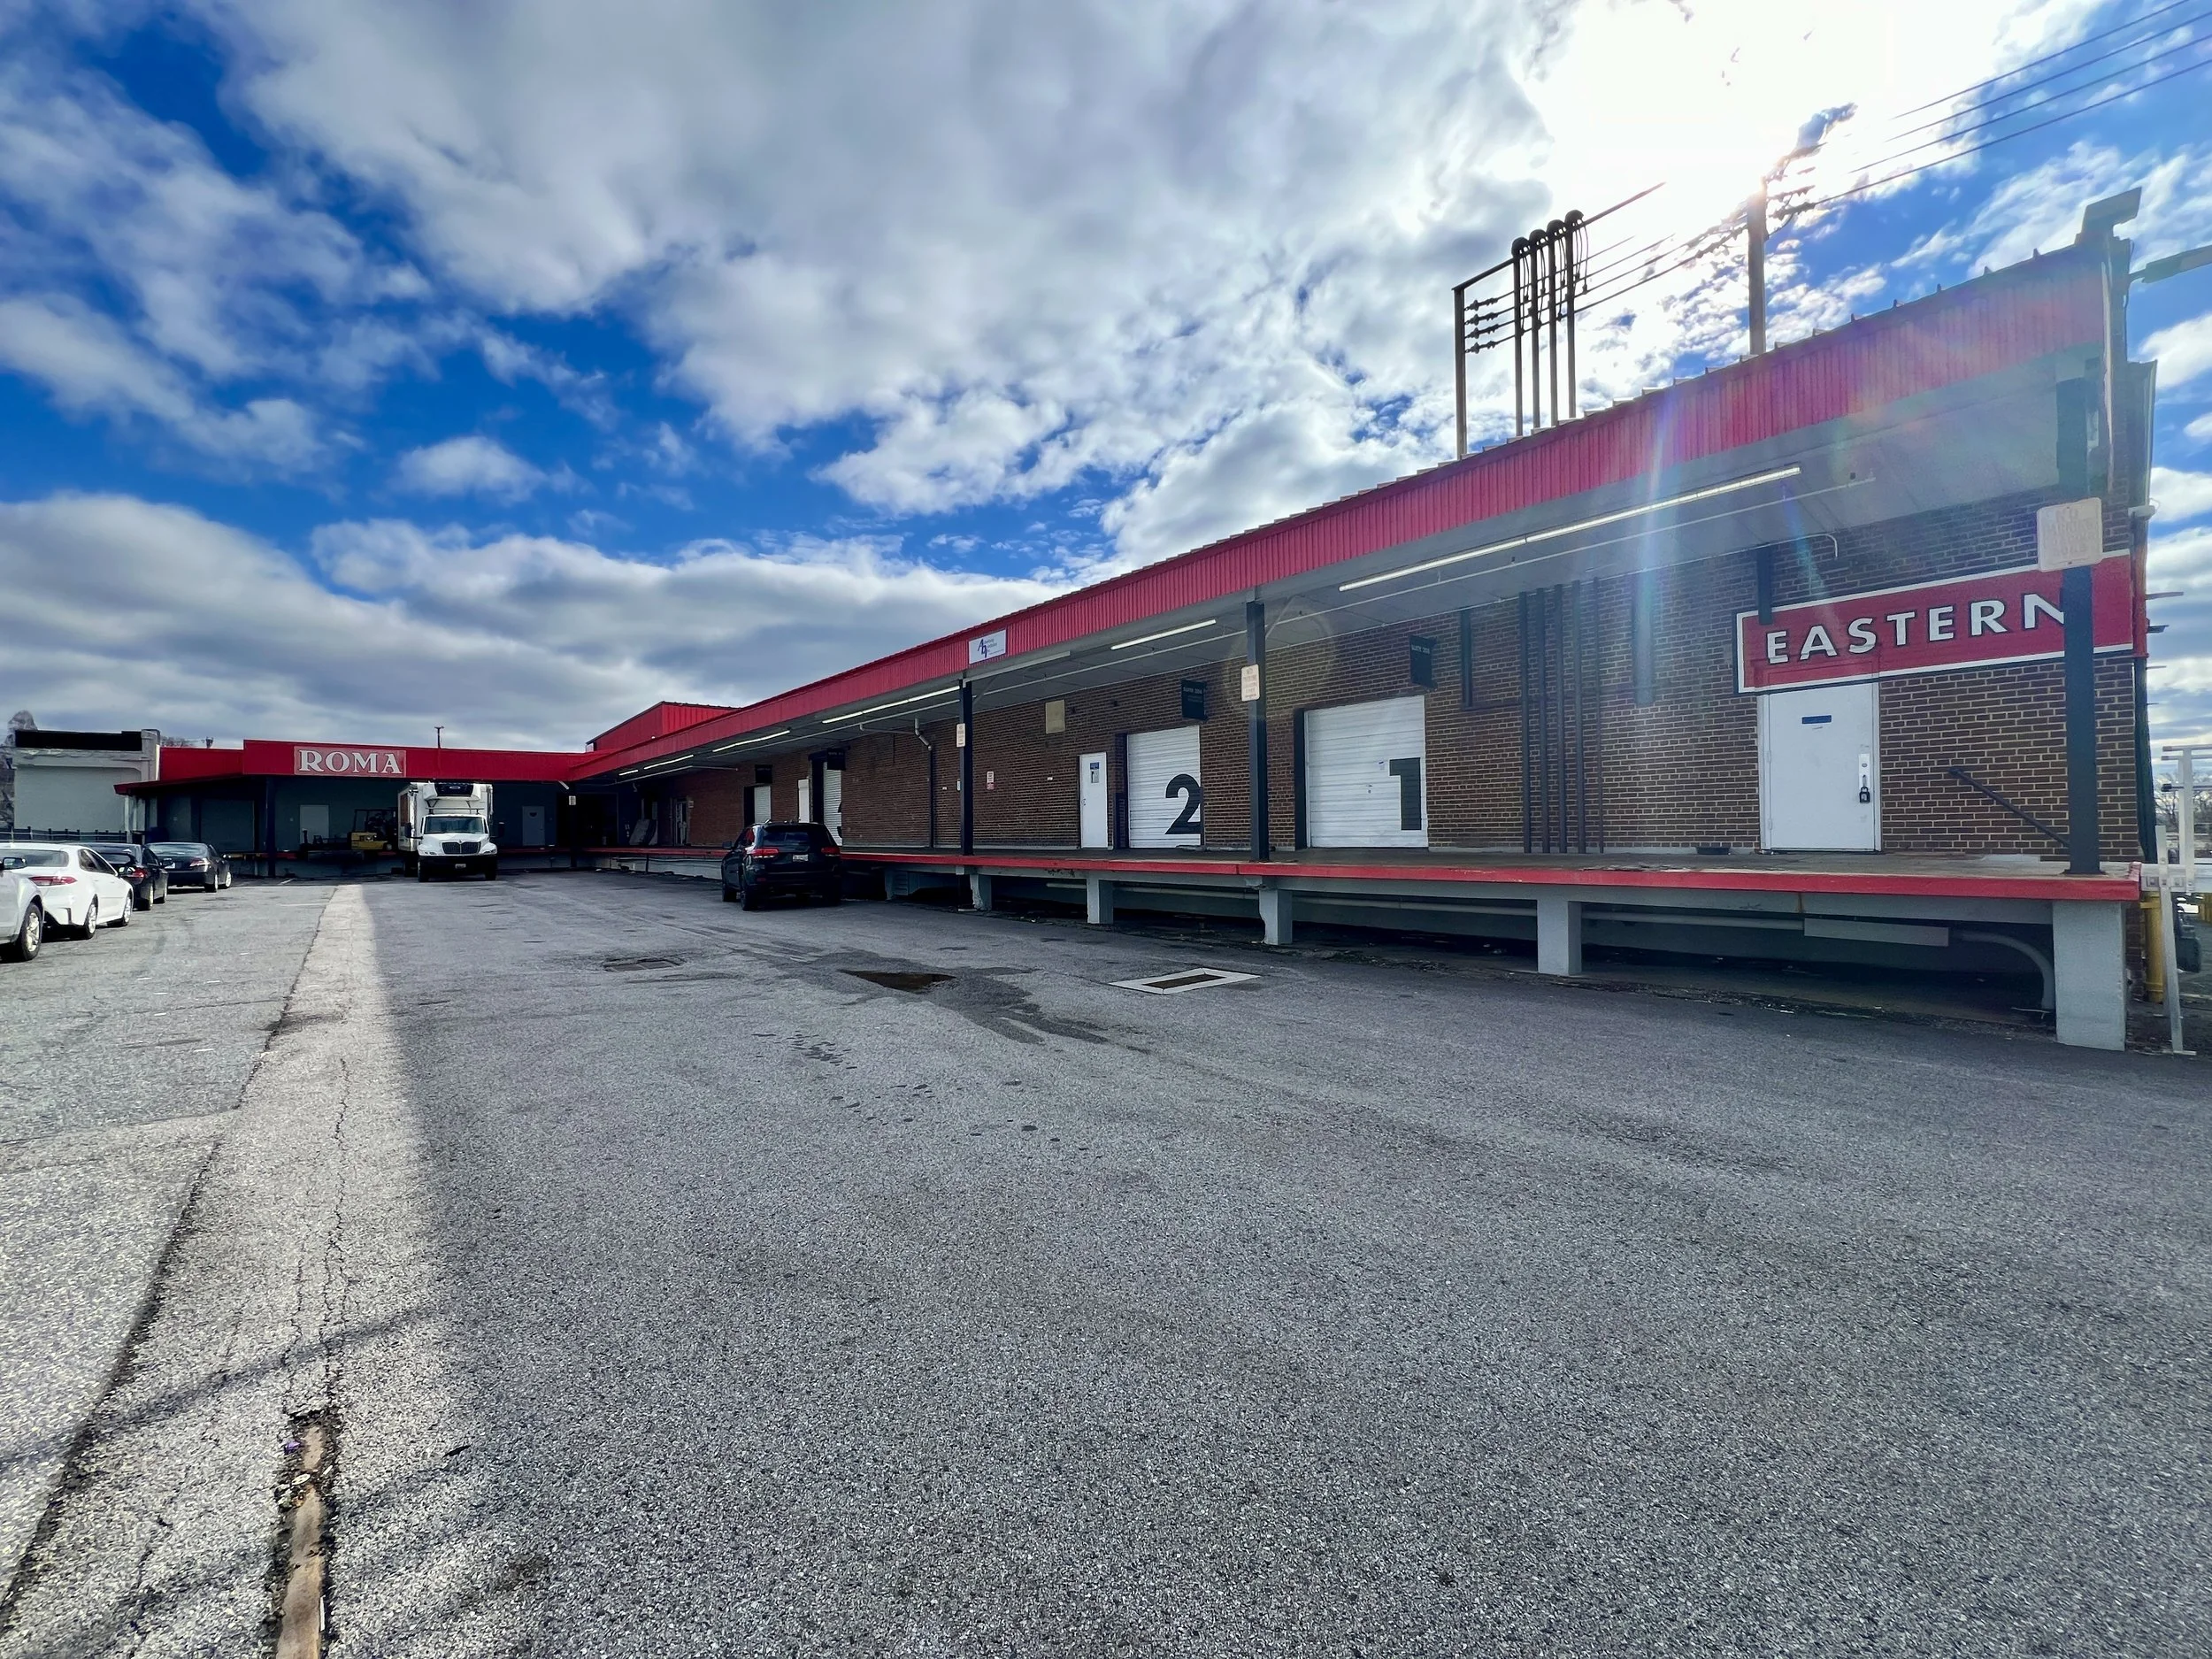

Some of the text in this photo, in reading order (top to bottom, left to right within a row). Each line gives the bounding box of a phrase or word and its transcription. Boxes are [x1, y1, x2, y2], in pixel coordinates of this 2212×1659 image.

[1766, 594, 2064, 664] EASTERN
[299, 749, 403, 774] ROMA
[1389, 757, 1422, 831] 1
[1164, 773, 1204, 835] 2
